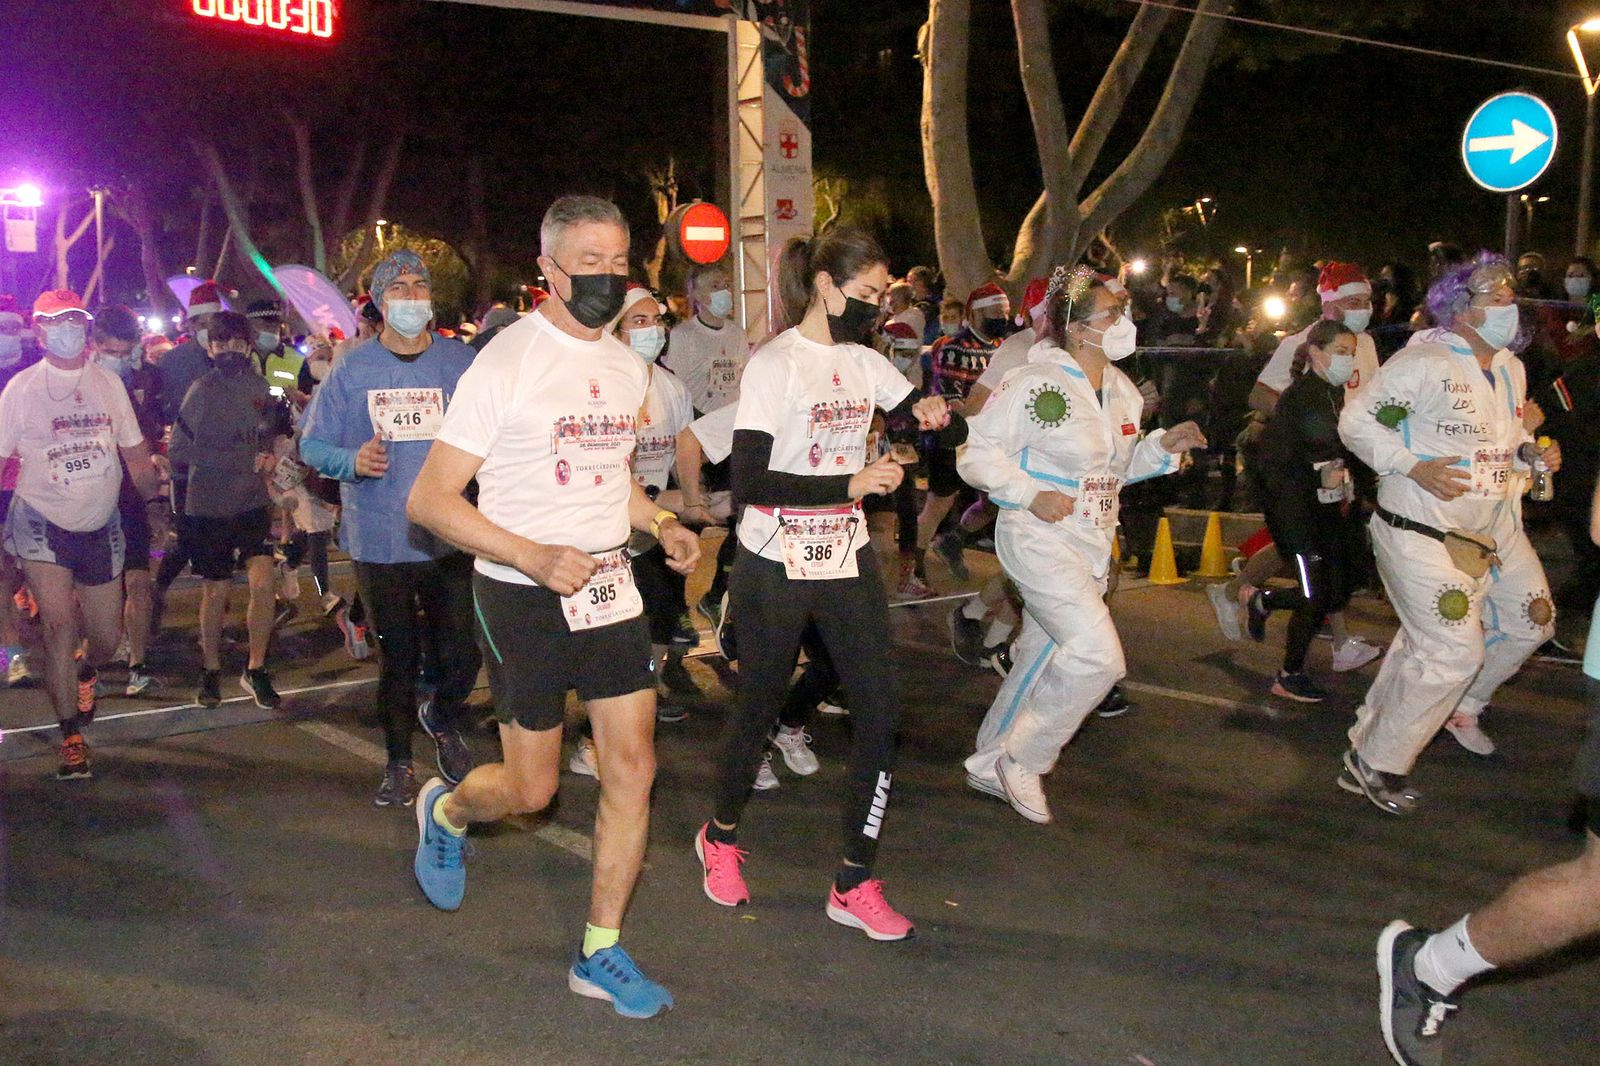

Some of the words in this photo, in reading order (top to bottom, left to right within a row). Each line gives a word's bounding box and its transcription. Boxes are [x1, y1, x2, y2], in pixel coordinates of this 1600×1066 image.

[393, 411, 422, 426] 416
[65, 458, 91, 473] 995
[1099, 499, 1113, 512] 154
[803, 544, 833, 562] 386
[588, 583, 617, 605] 385
[863, 770, 892, 840] NIKE
